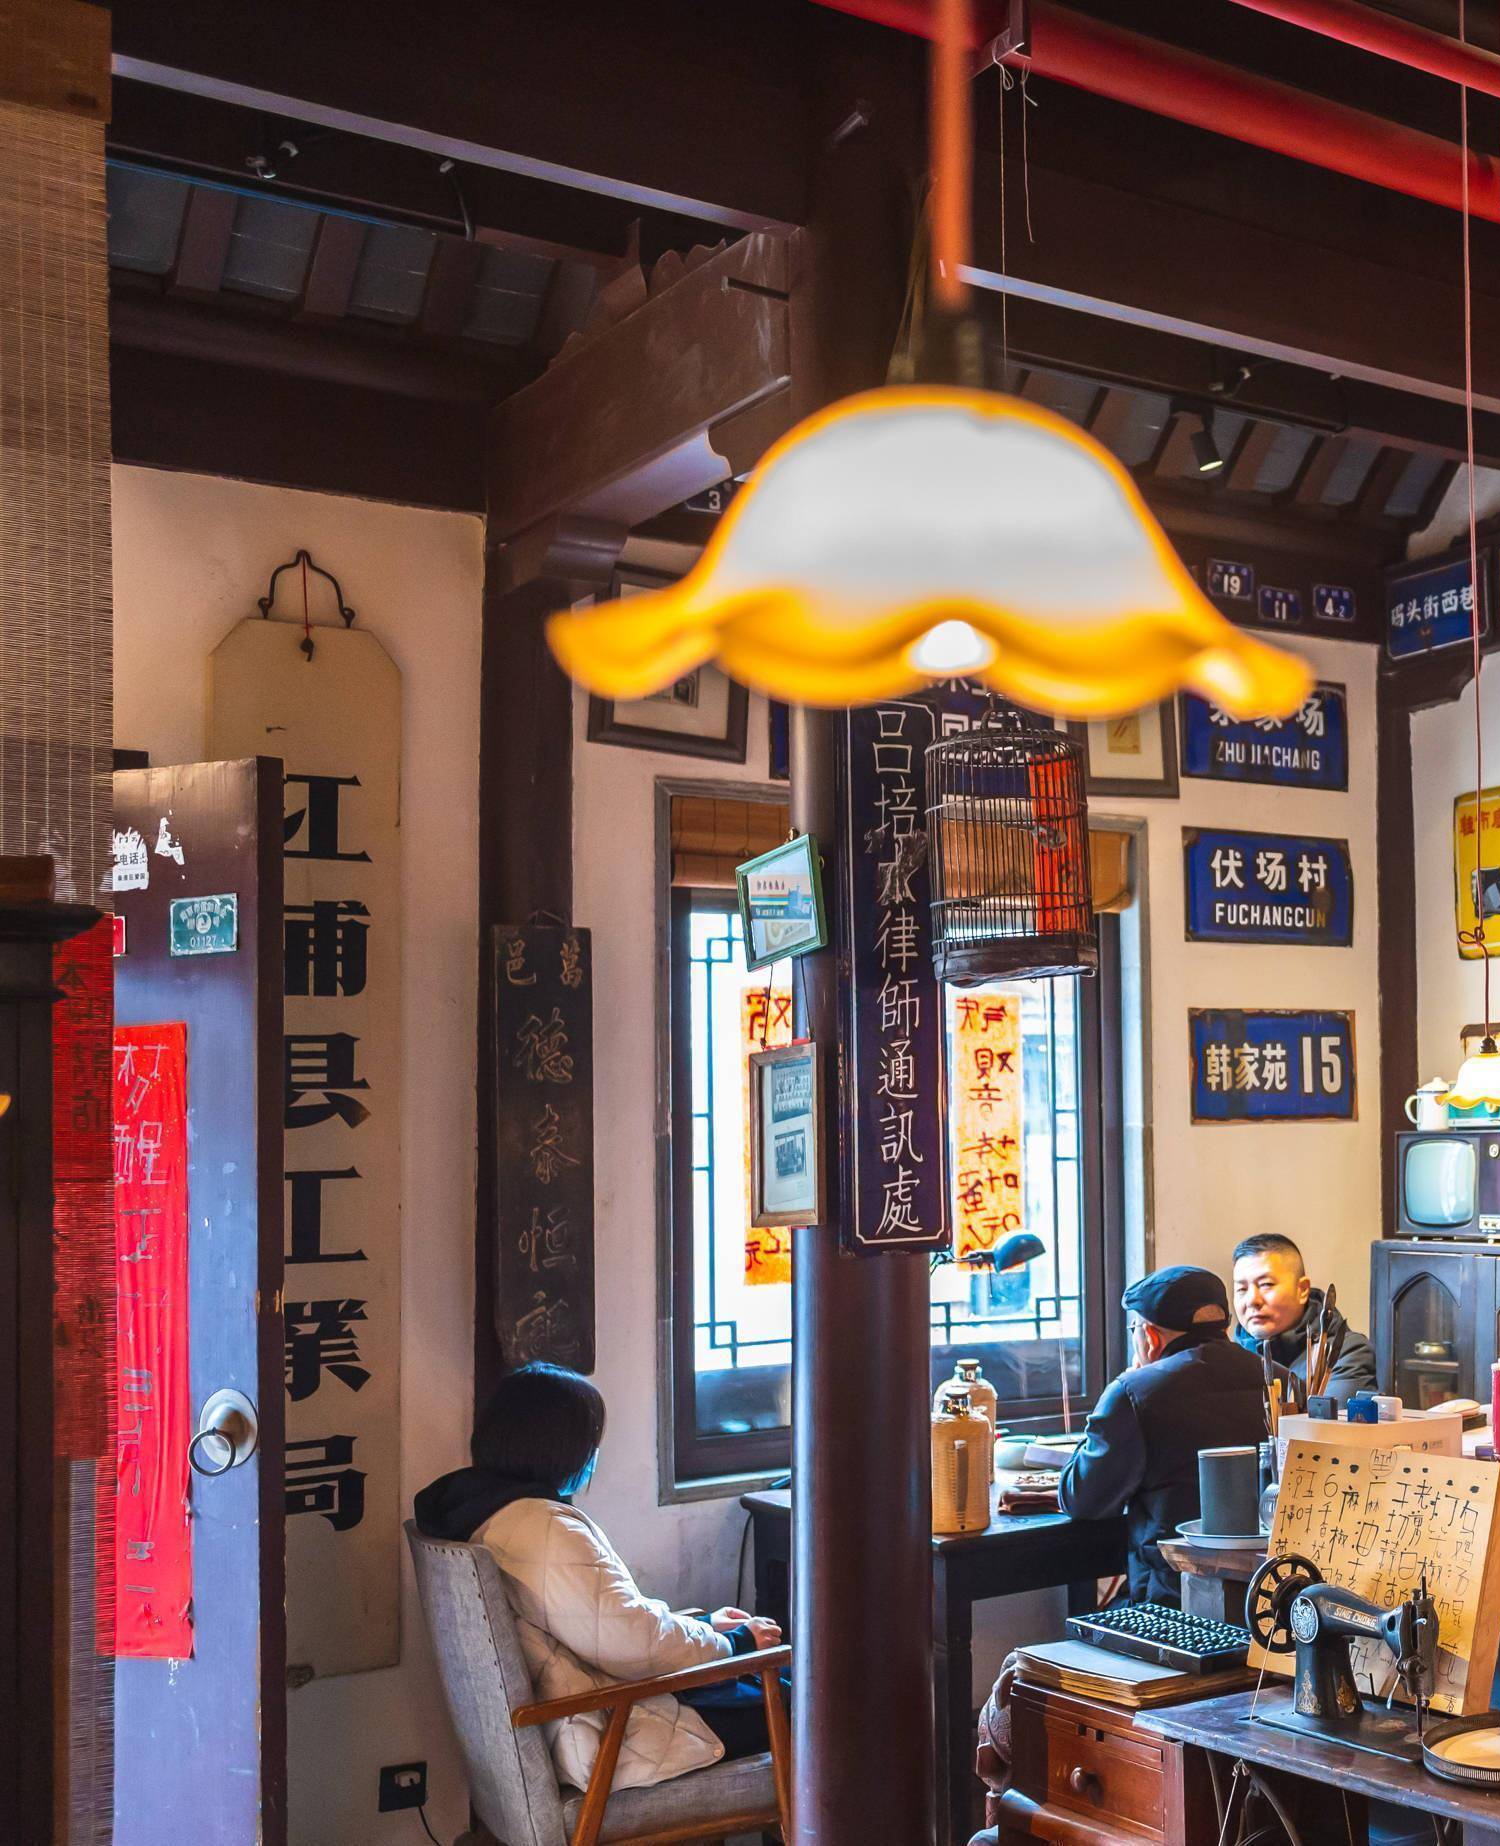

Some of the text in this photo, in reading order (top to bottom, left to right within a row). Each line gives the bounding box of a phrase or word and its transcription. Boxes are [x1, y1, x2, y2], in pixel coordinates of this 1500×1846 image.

[1210, 848, 1328, 893] 伏场村
[1215, 902, 1327, 929] FUCHANGCUN
[189, 934, 217, 947] 01127
[1206, 1036, 1342, 1094] 韩家苑 15
